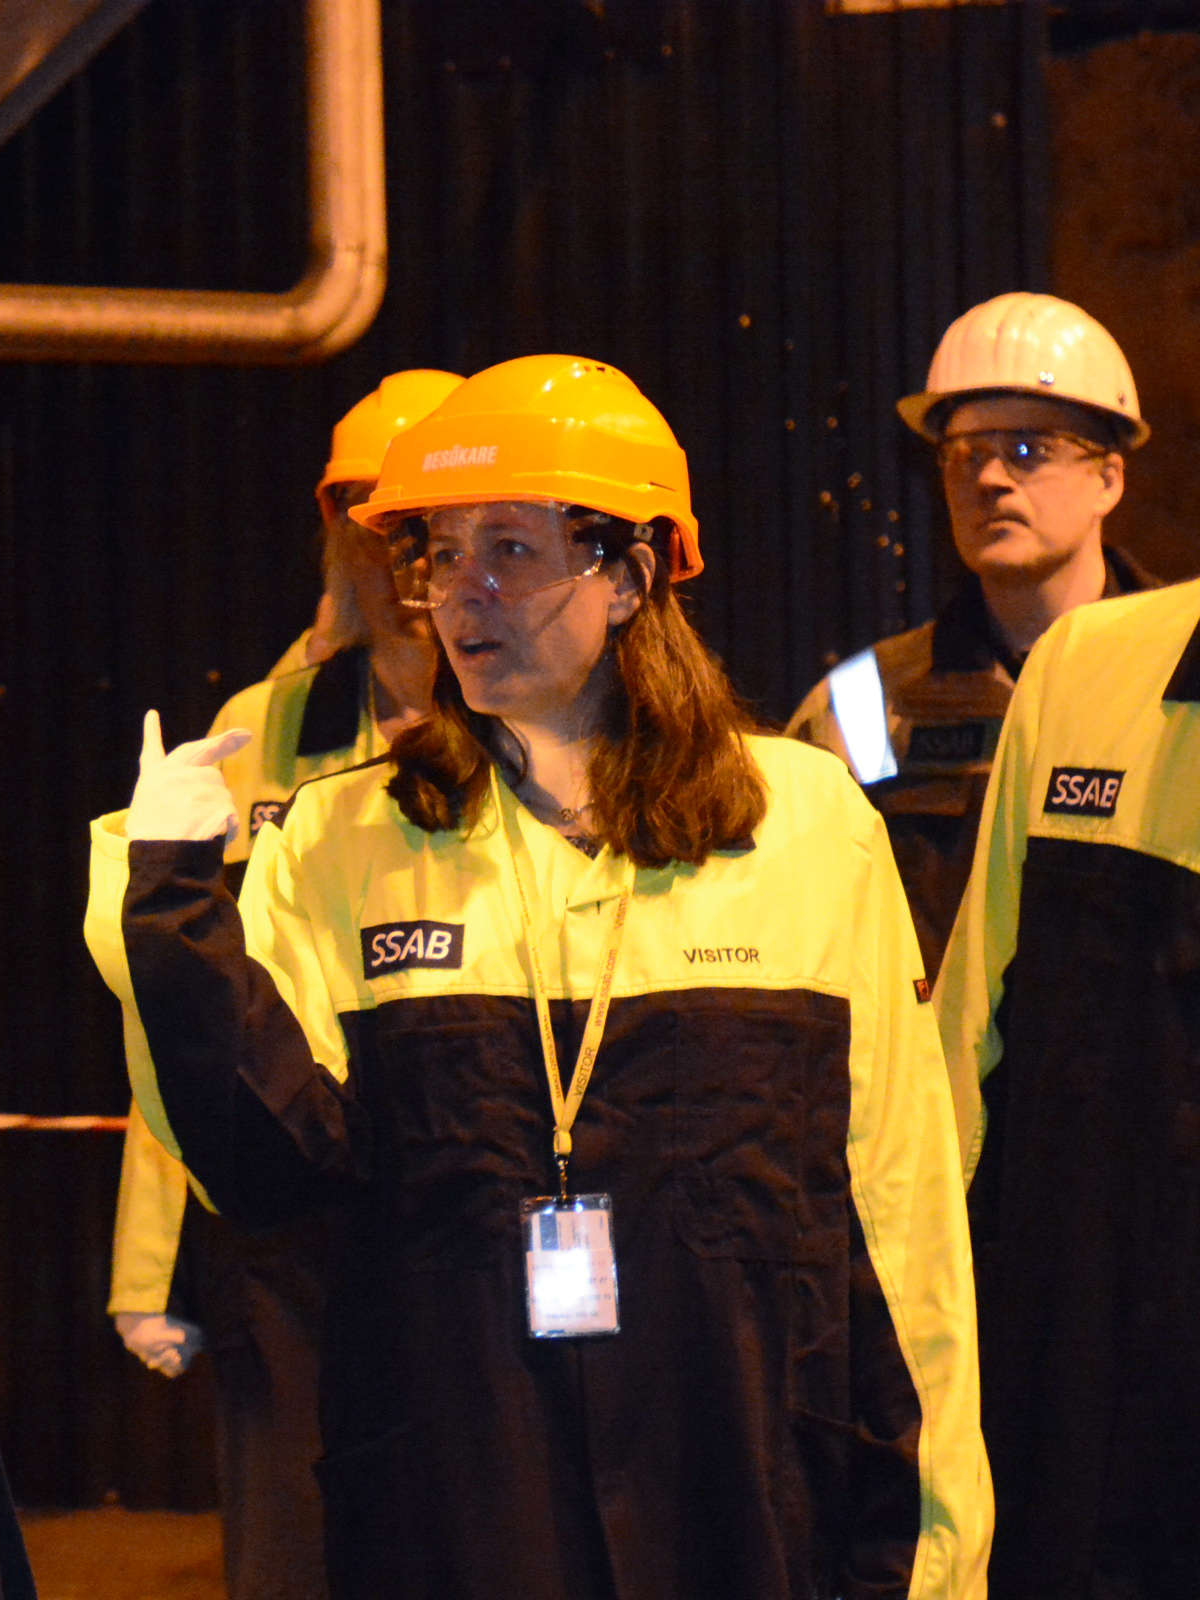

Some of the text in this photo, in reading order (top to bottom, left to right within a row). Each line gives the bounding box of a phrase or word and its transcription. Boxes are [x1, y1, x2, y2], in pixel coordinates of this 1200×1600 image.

[1051, 774, 1119, 808] SSAB
[371, 928, 453, 967] SSAB
[683, 947, 761, 964] VISITOR
[574, 1047, 596, 1096] VISITOR
[595, 949, 618, 1027] www.ssab.com
